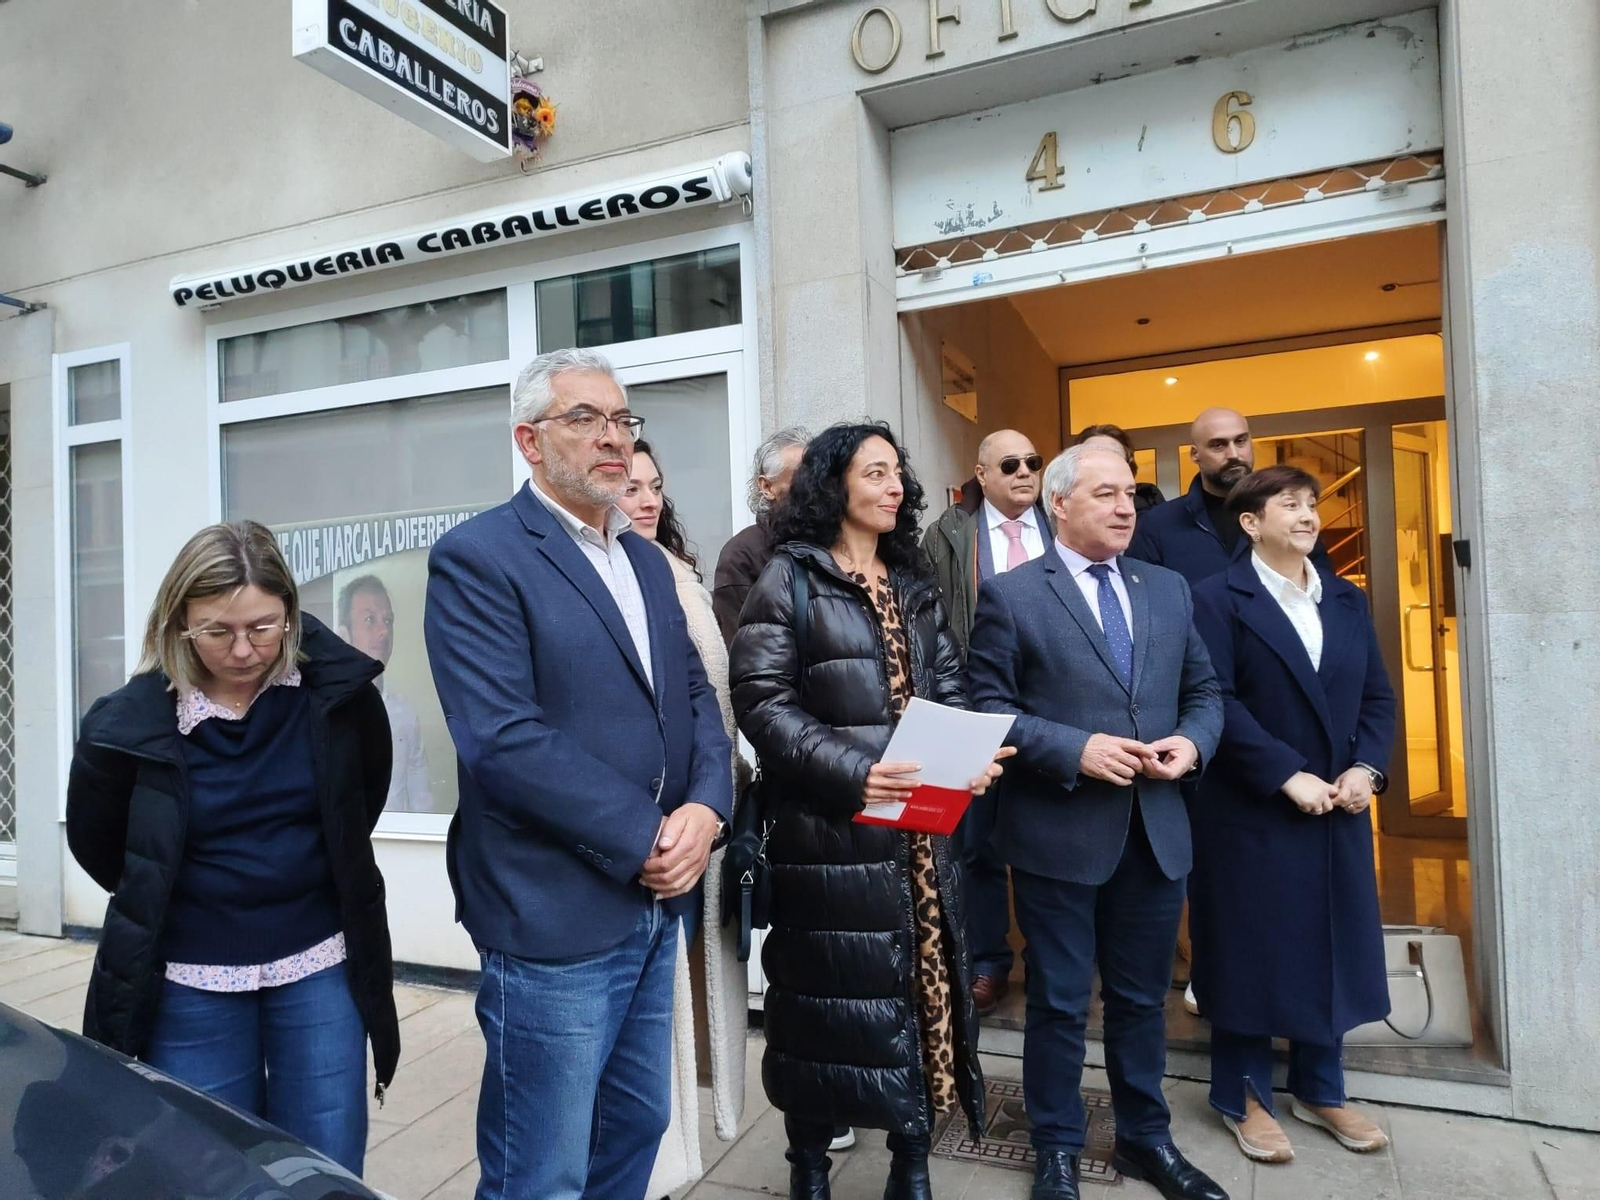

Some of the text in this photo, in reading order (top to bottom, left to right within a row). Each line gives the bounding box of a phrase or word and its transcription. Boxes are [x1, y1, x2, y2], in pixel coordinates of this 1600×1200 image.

[338, 17, 500, 135] CABALLEROS
[368, 0, 483, 74] UGENIO
[1026, 131, 1066, 192] 4
[1212, 91, 1256, 154] 6
[173, 175, 713, 307] PELUQUERIA CABALLEROS
[293, 528, 320, 586] QUE
[322, 522, 372, 574] MARCA
[374, 519, 393, 559] LA
